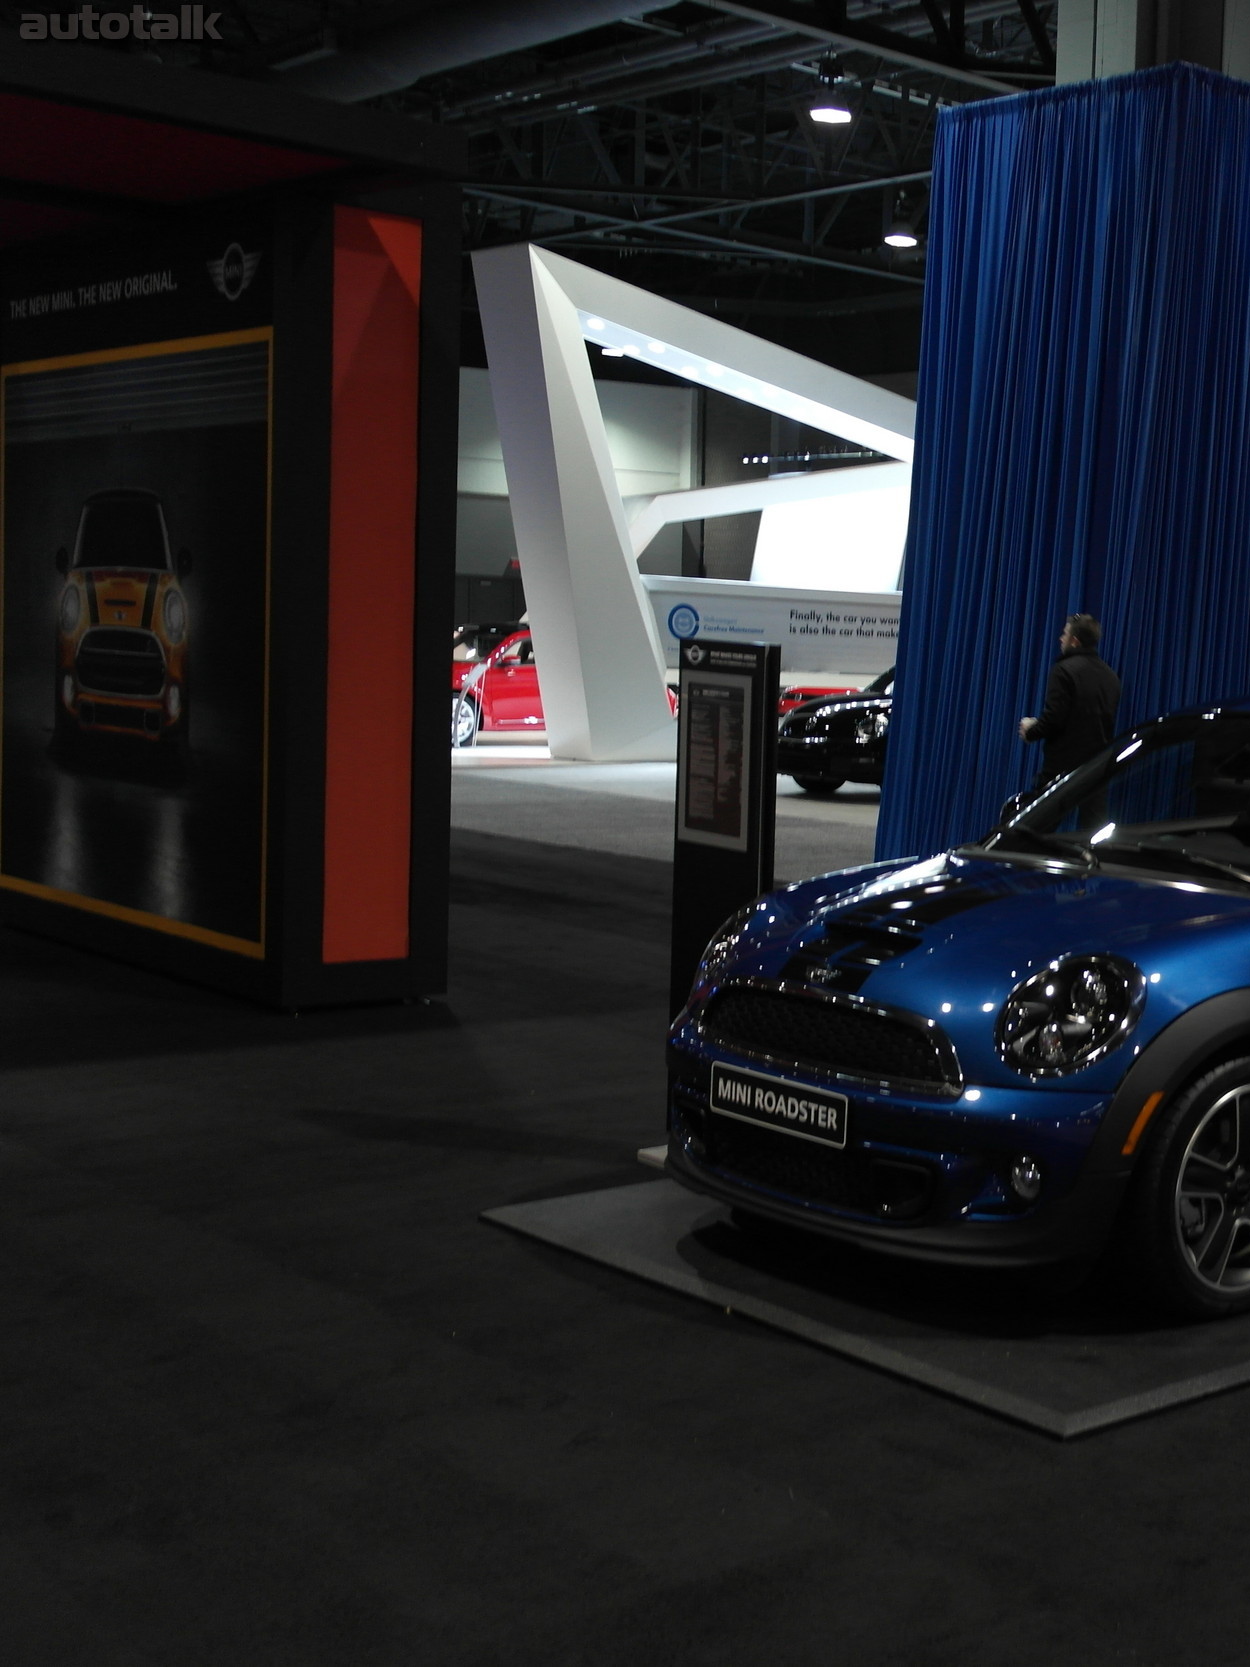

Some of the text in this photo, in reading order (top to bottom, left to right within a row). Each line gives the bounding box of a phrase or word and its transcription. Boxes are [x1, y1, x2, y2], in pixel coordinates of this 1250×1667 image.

[10, 269, 178, 320] THE NEW MINI. THE NEW ORIGINAL.
[789, 608, 900, 626] Finally, the car you wan
[789, 623, 797, 634] is
[799, 624, 820, 635] also
[822, 624, 837, 635] the
[839, 628, 854, 636] car
[855, 626, 874, 637] that
[718, 1077, 838, 1131] MINI ROADSTER
